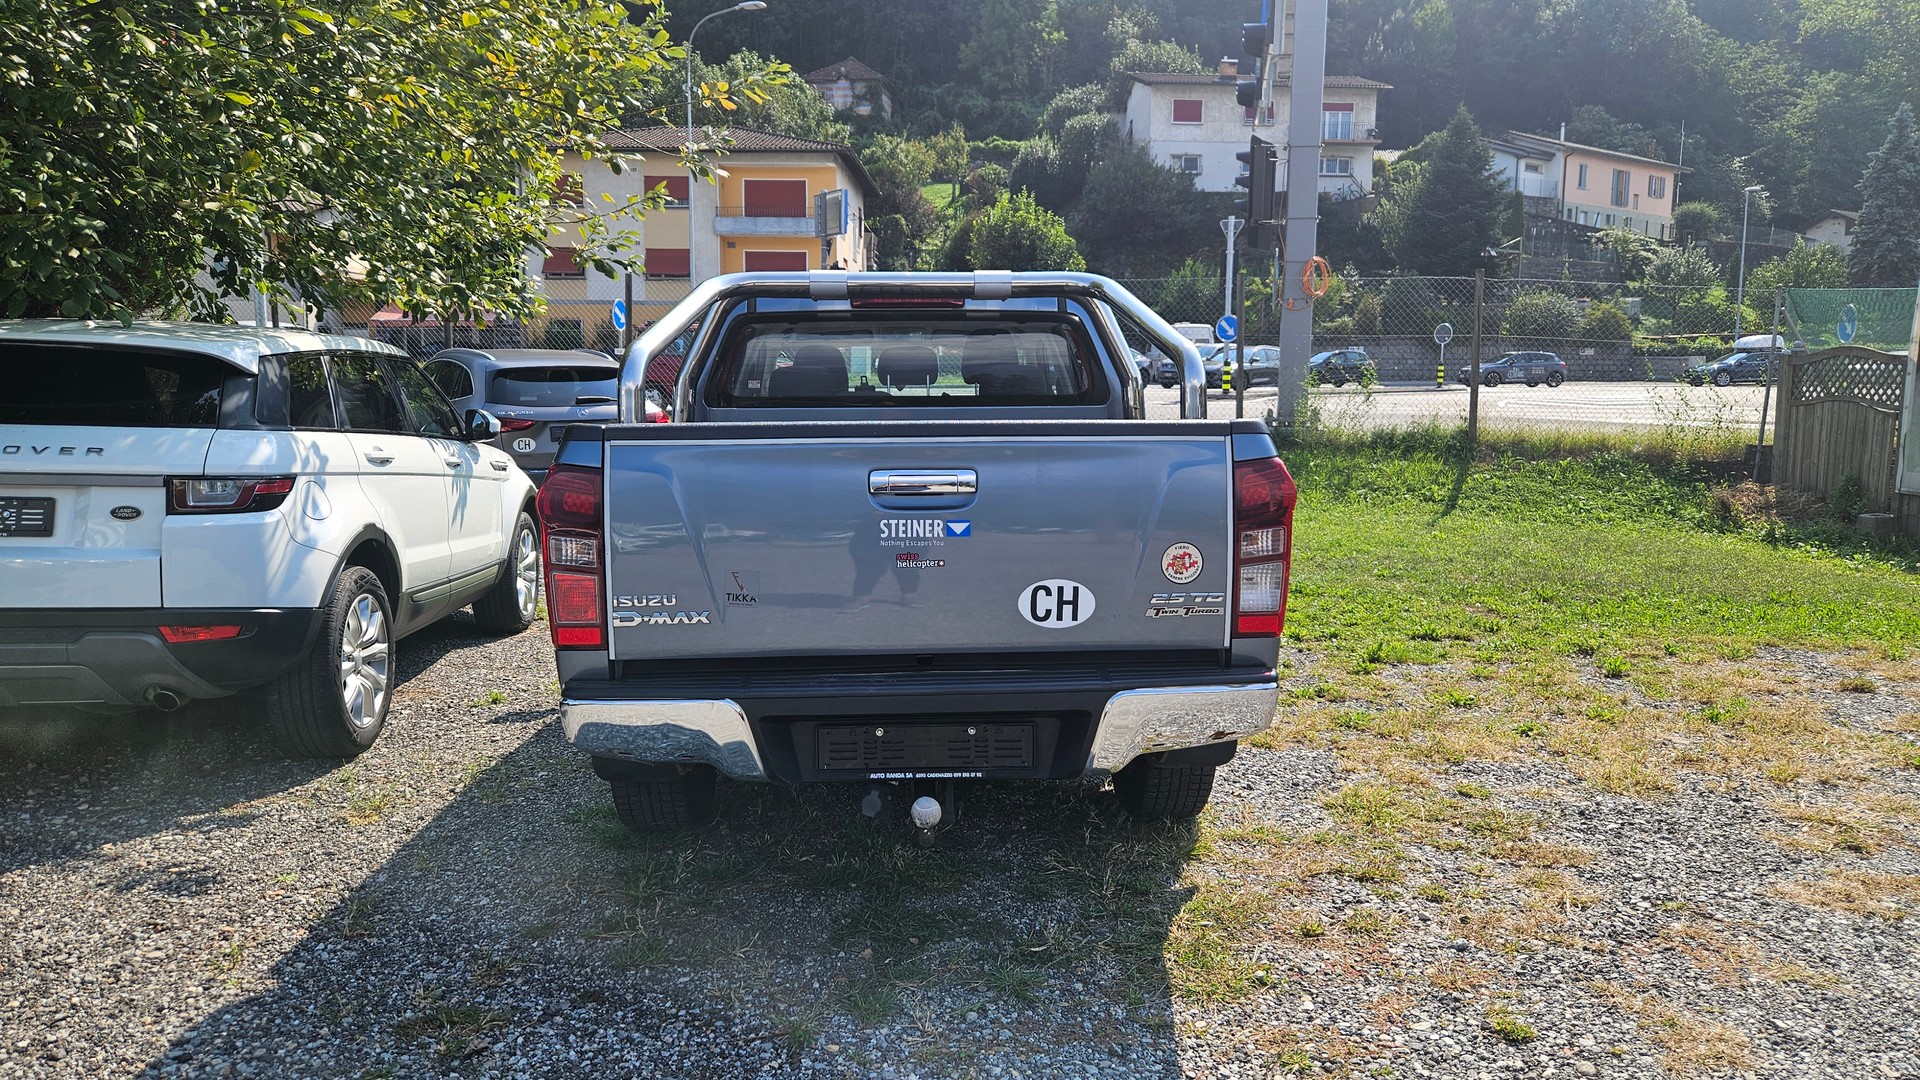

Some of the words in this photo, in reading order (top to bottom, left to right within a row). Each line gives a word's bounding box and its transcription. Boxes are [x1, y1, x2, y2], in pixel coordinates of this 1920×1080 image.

[517, 439, 531, 451] CH
[880, 519, 944, 538] STEINER
[880, 540, 905, 548] Nothing
[906, 540, 932, 548] Escapes
[897, 560, 939, 569] helicopter
[613, 594, 677, 607] ISUZU
[726, 592, 758, 603] TIKKA
[1030, 584, 1080, 623] CH
[613, 610, 711, 627] D-MAX
